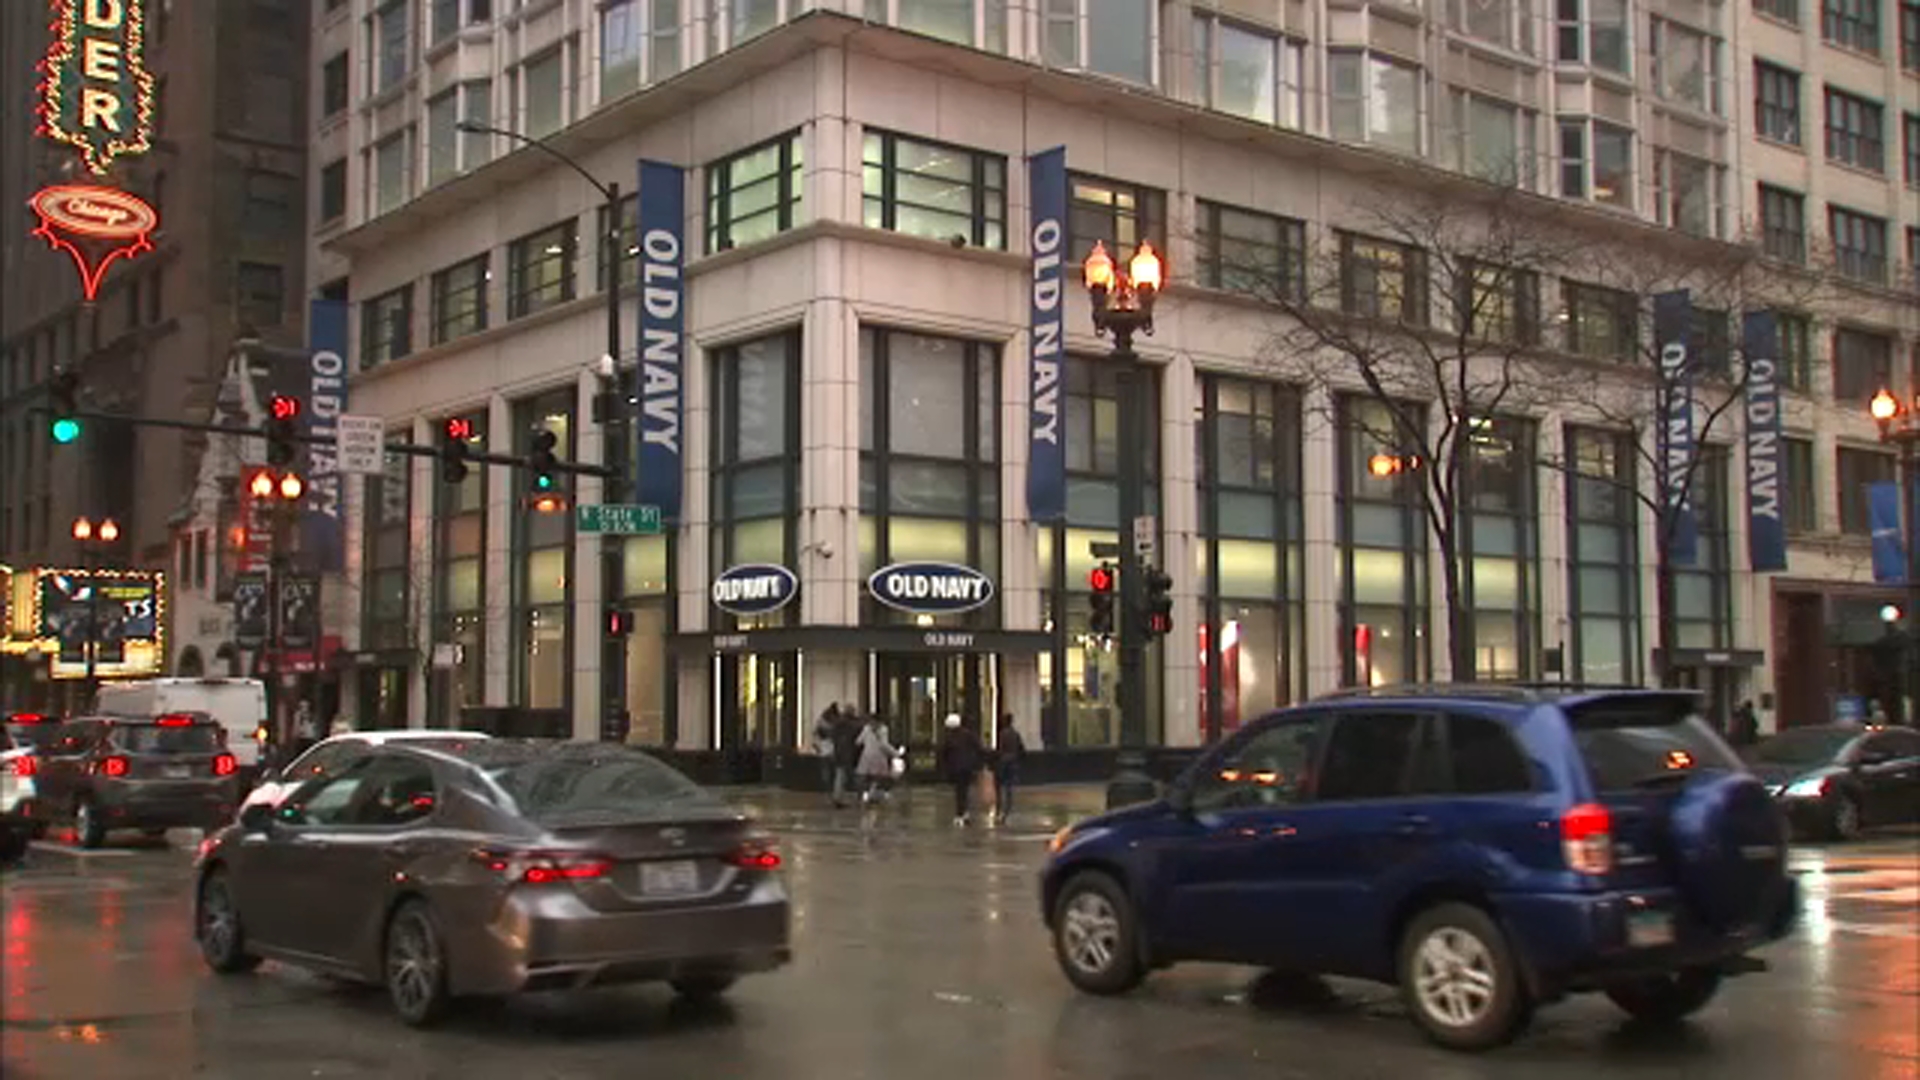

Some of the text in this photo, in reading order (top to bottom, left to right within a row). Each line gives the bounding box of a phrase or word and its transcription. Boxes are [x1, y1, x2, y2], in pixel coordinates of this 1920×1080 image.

[643, 229, 679, 454] OLD NAVY
[1033, 219, 1061, 445] OLD NAVY
[310, 351, 343, 419] OLD
[1748, 358, 1779, 521] OLD NAVY
[598, 506, 633, 520] State
[641, 507, 656, 522] St
[713, 576, 780, 601] OLD NAVY
[888, 574, 982, 599] OLD NAVY
[924, 632, 973, 646] OLD NAVY
